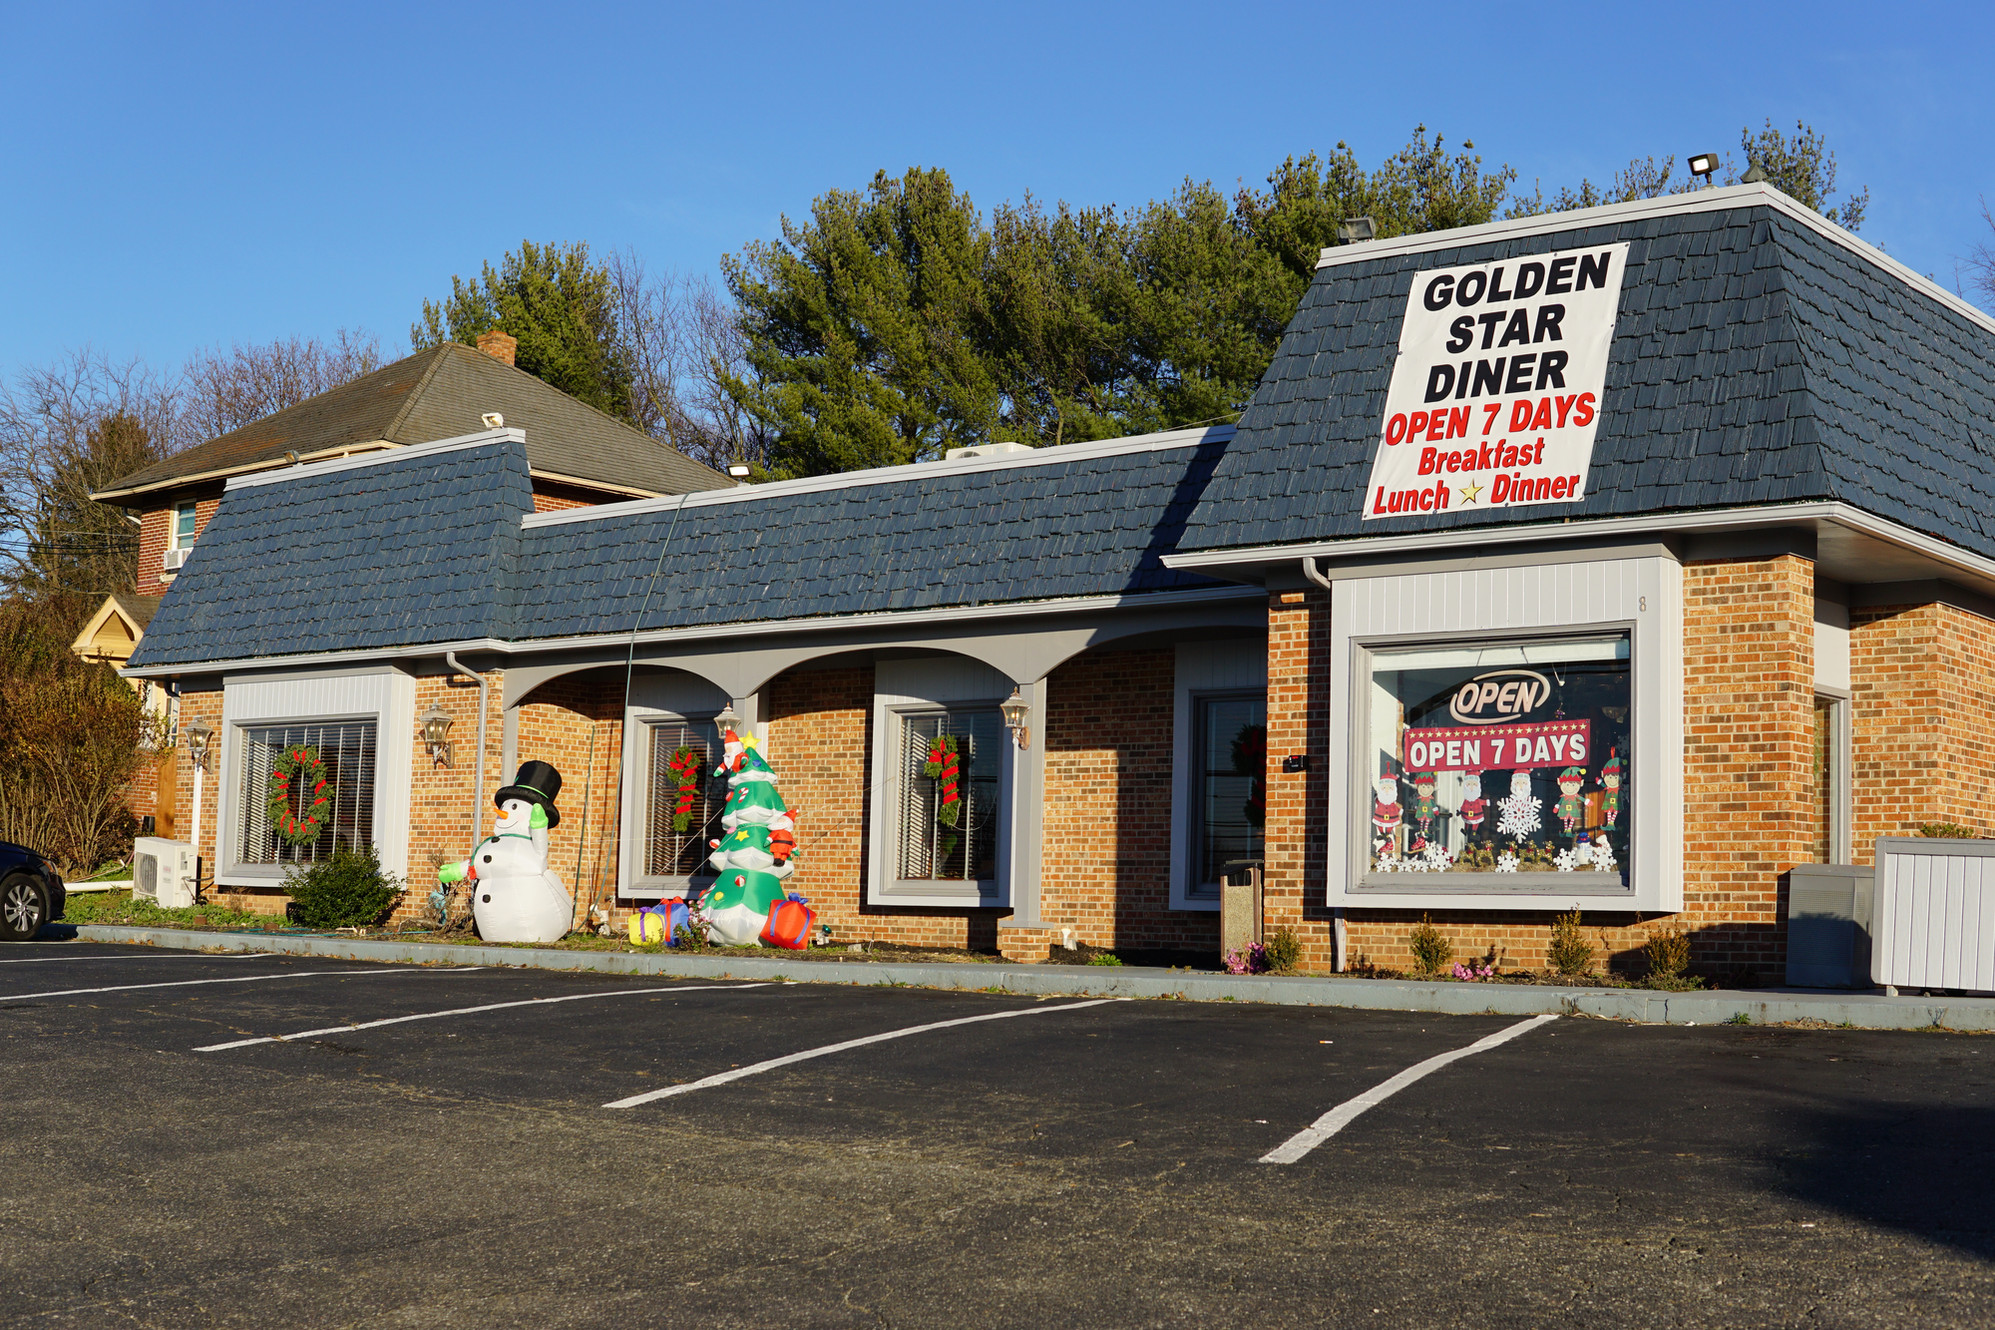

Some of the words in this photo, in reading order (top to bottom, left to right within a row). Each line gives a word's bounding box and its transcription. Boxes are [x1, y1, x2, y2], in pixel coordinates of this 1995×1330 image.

[1423, 252, 1612, 312] GOLDEN
[1445, 303, 1566, 354] STAR
[1423, 350, 1569, 403] DINER
[1385, 405, 1471, 446] OPEN
[1481, 403, 1501, 435] 7
[1508, 392, 1596, 433] DAYS
[1417, 437, 1545, 476] Breakfast
[1373, 480, 1450, 515] Lunch
[1490, 472, 1580, 503] Dinner
[1456, 681, 1540, 714] OPEN
[1410, 739, 1481, 767] OPEN
[1490, 739, 1505, 764] 7
[1515, 733, 1586, 763] DAYS
